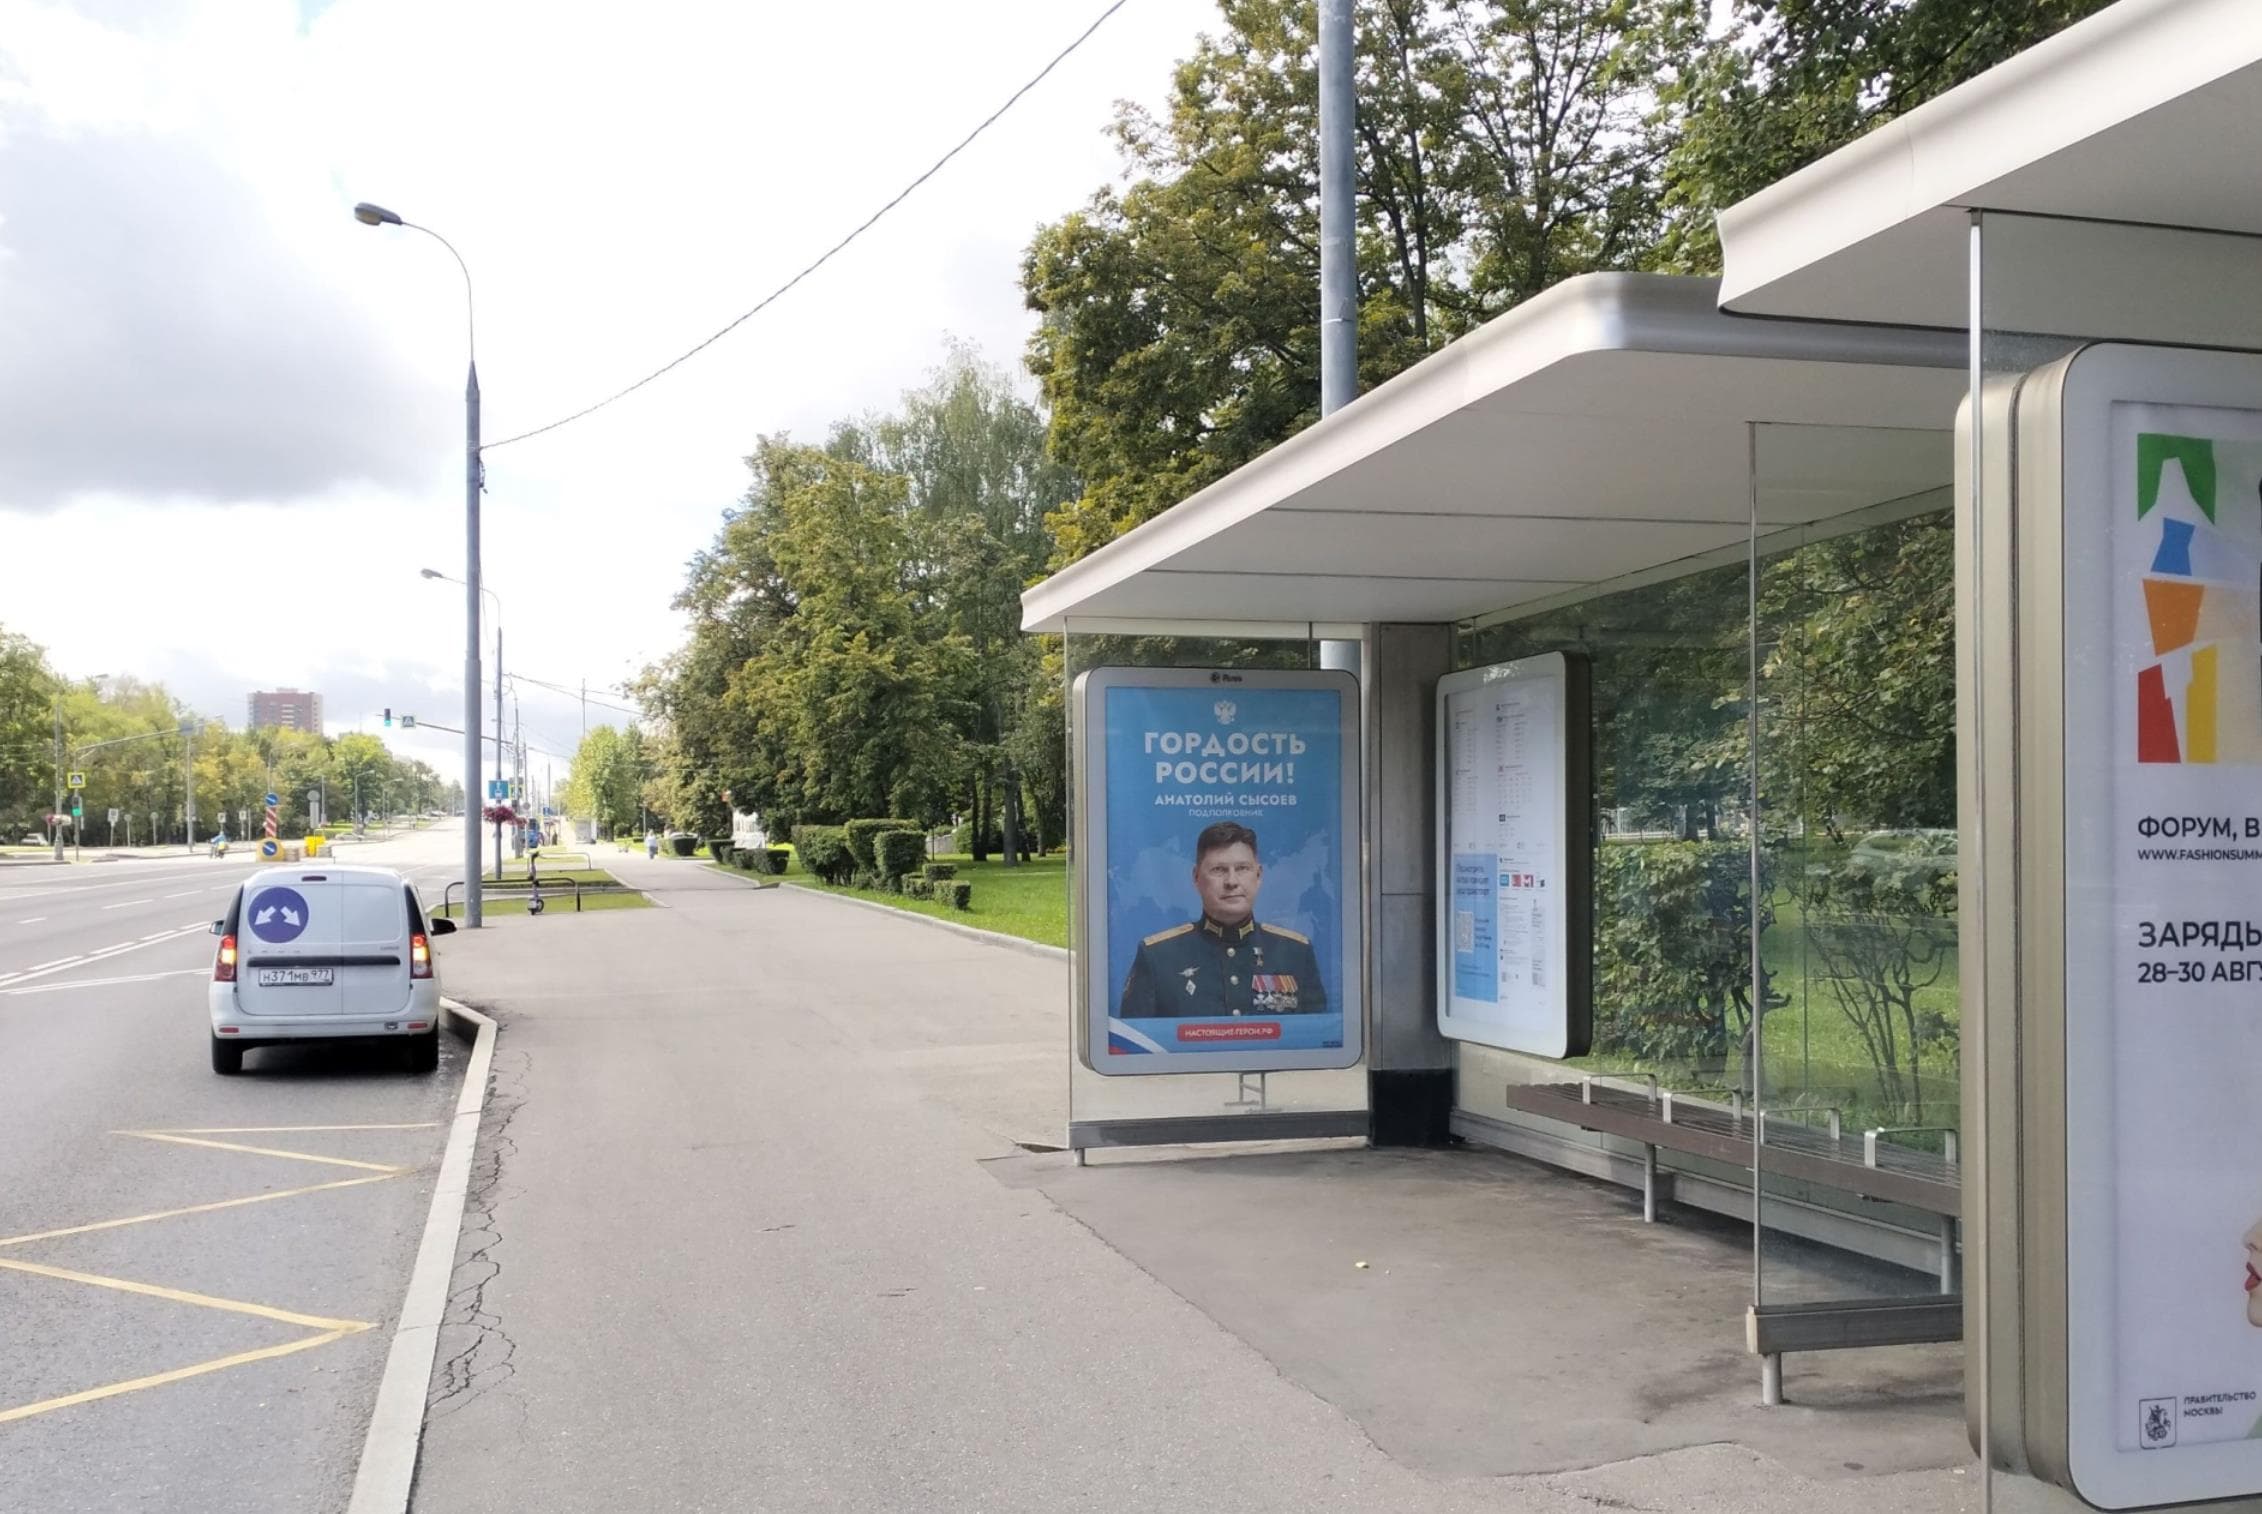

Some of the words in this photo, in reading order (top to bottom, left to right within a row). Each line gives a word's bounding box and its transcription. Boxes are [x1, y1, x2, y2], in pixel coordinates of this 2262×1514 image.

[1144, 731, 1307, 757] ГОРДОСТЬ
[1155, 761, 1294, 784] РОССИИ!
[1154, 791, 1234, 806] АНАТОЛИЙ
[1238, 794, 1297, 806] СЫСОЕВ
[1188, 808, 1263, 817] ПОДПОЛКОВНИК
[2138, 816, 2237, 842] ФОРУМ,
[2138, 921, 2262, 951] ЗАРЯДЬ
[2184, 1391, 2256, 1404] ПРАВИТЕЛЬСТВО
[2184, 1407, 2223, 1417] МОСКВЫ
